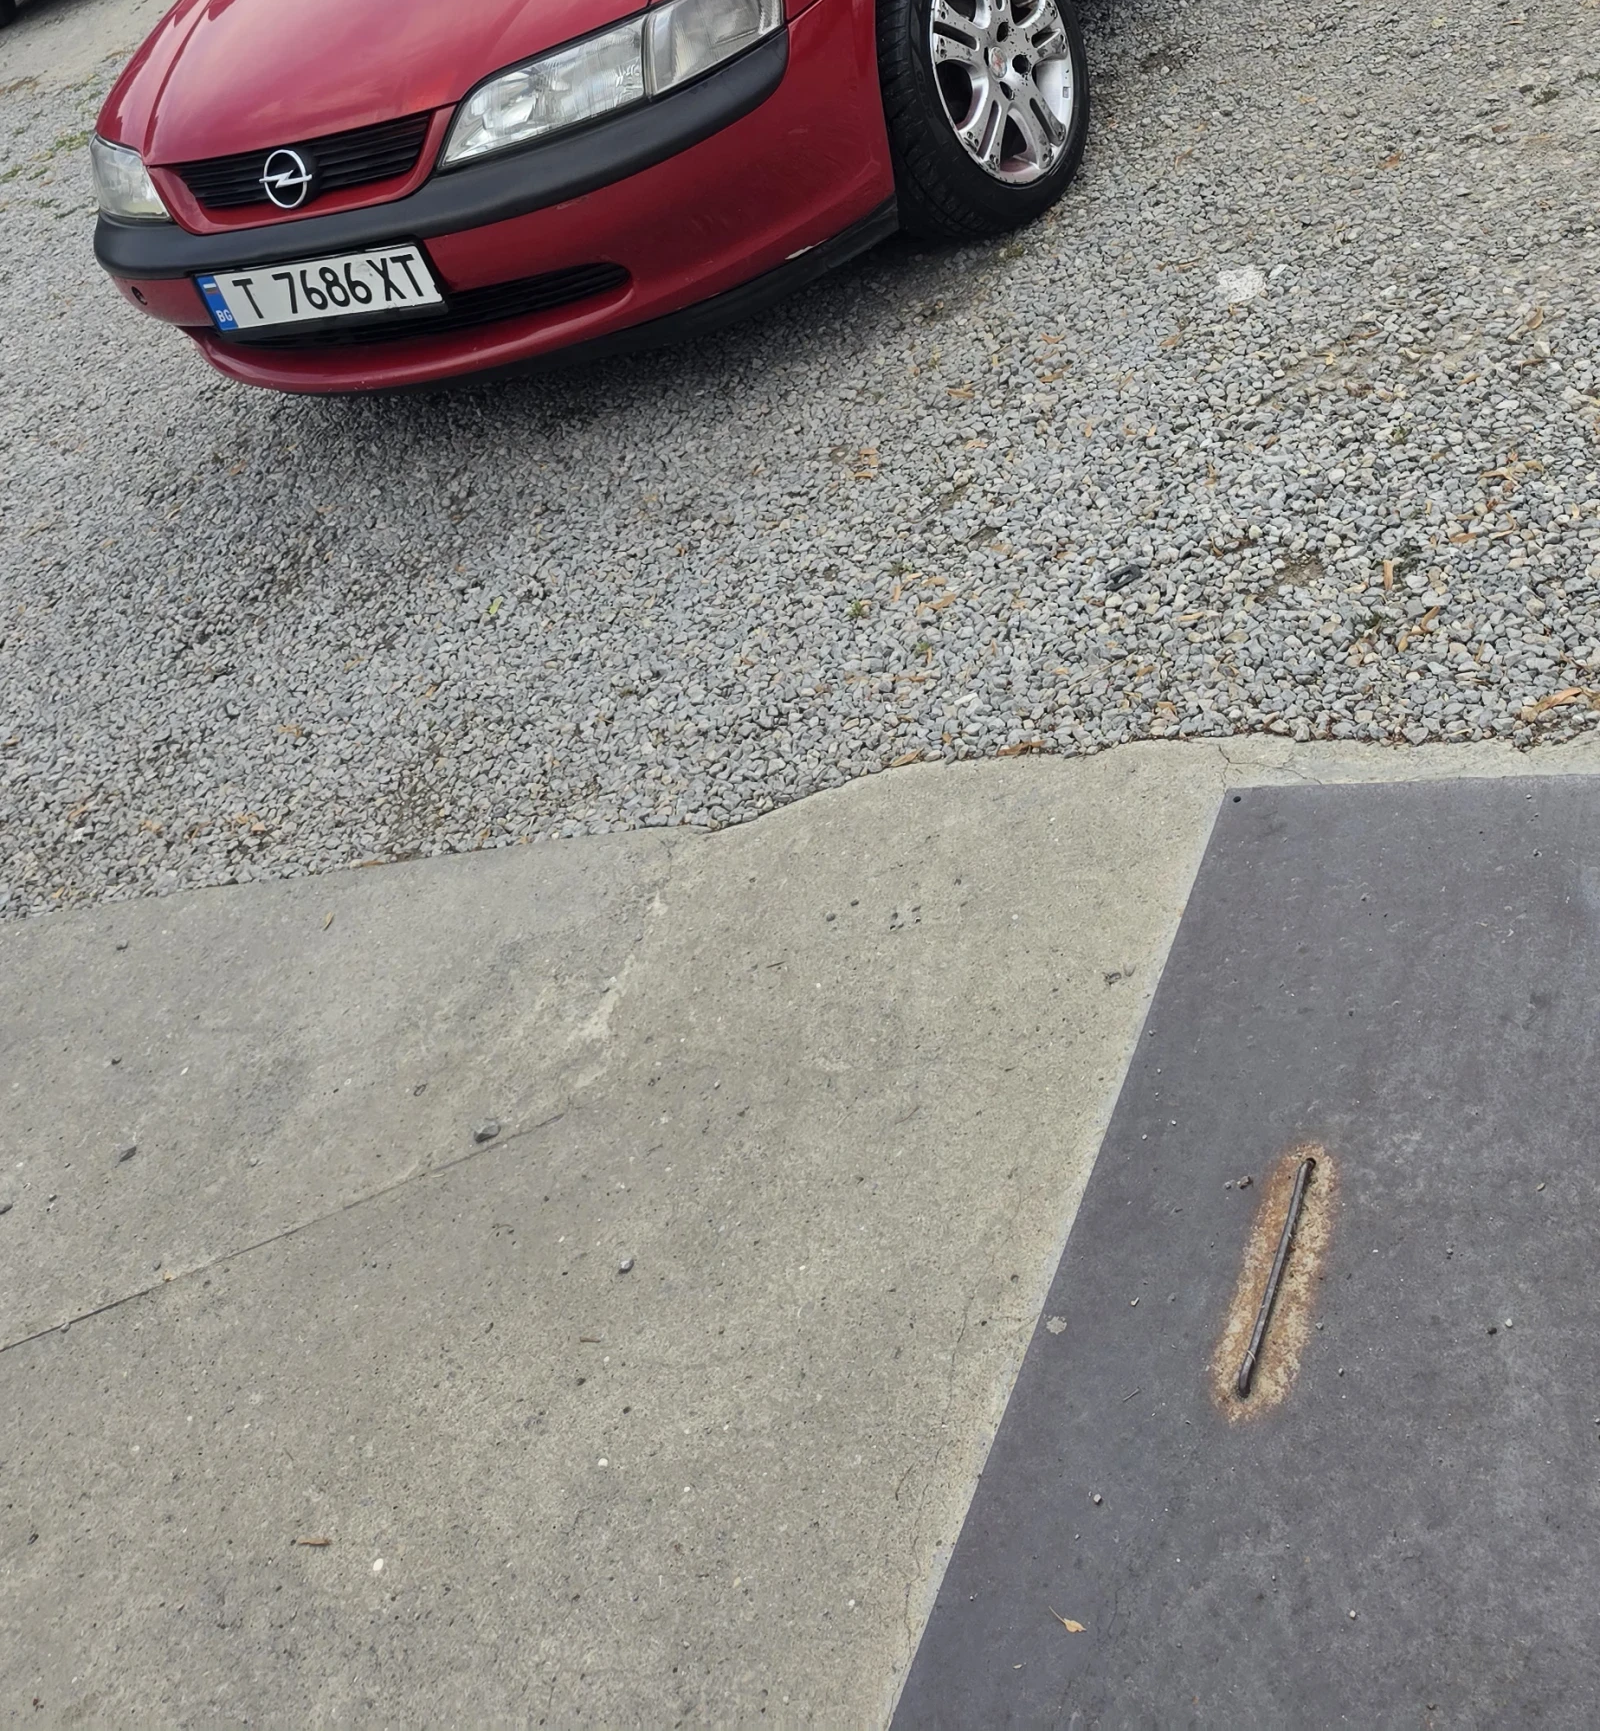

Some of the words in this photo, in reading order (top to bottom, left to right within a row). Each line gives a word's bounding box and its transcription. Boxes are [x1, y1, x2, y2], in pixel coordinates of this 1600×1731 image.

[231, 278, 264, 319] T
[271, 262, 372, 314] 7686
[366, 253, 424, 301] XT
[215, 309, 233, 323] BG
